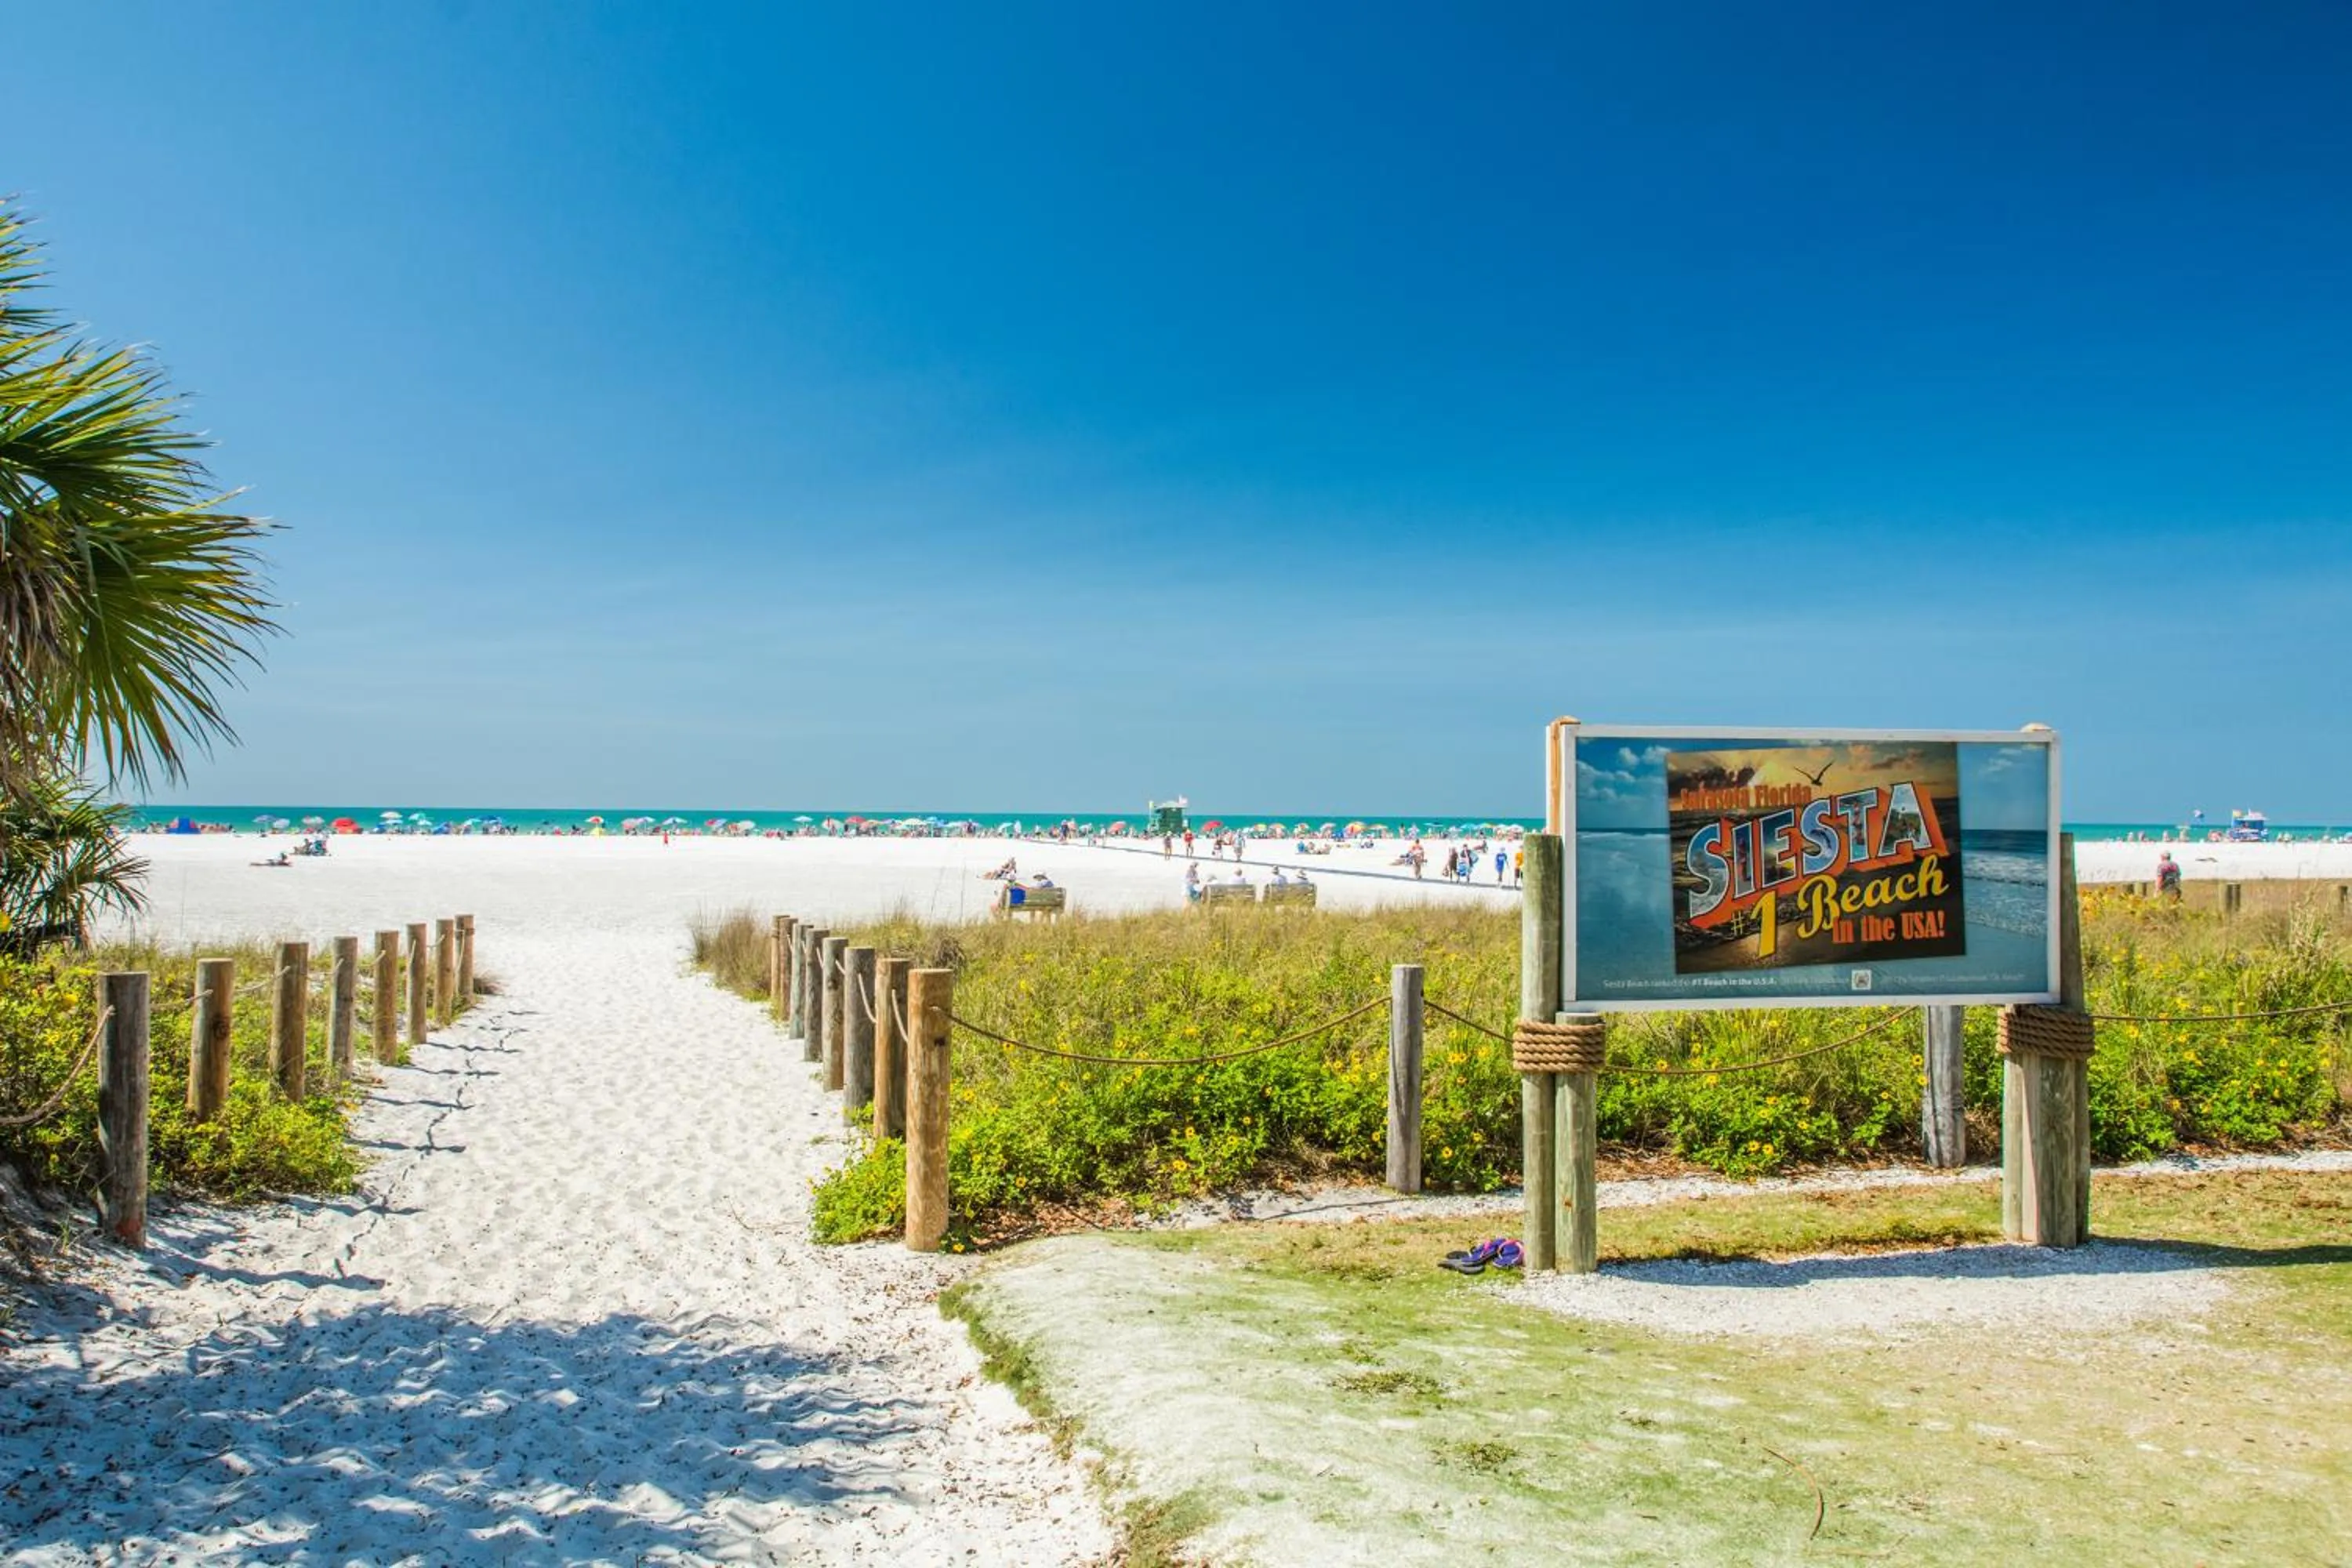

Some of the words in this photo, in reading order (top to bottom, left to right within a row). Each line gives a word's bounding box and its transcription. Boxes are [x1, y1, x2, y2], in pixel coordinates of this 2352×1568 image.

[1755, 782, 1811, 808] Florida
[1687, 781, 1940, 924] SIESTA
[1797, 855, 1949, 938] Beach
[1861, 915, 1896, 942] the
[1901, 910, 1946, 940] USA!
